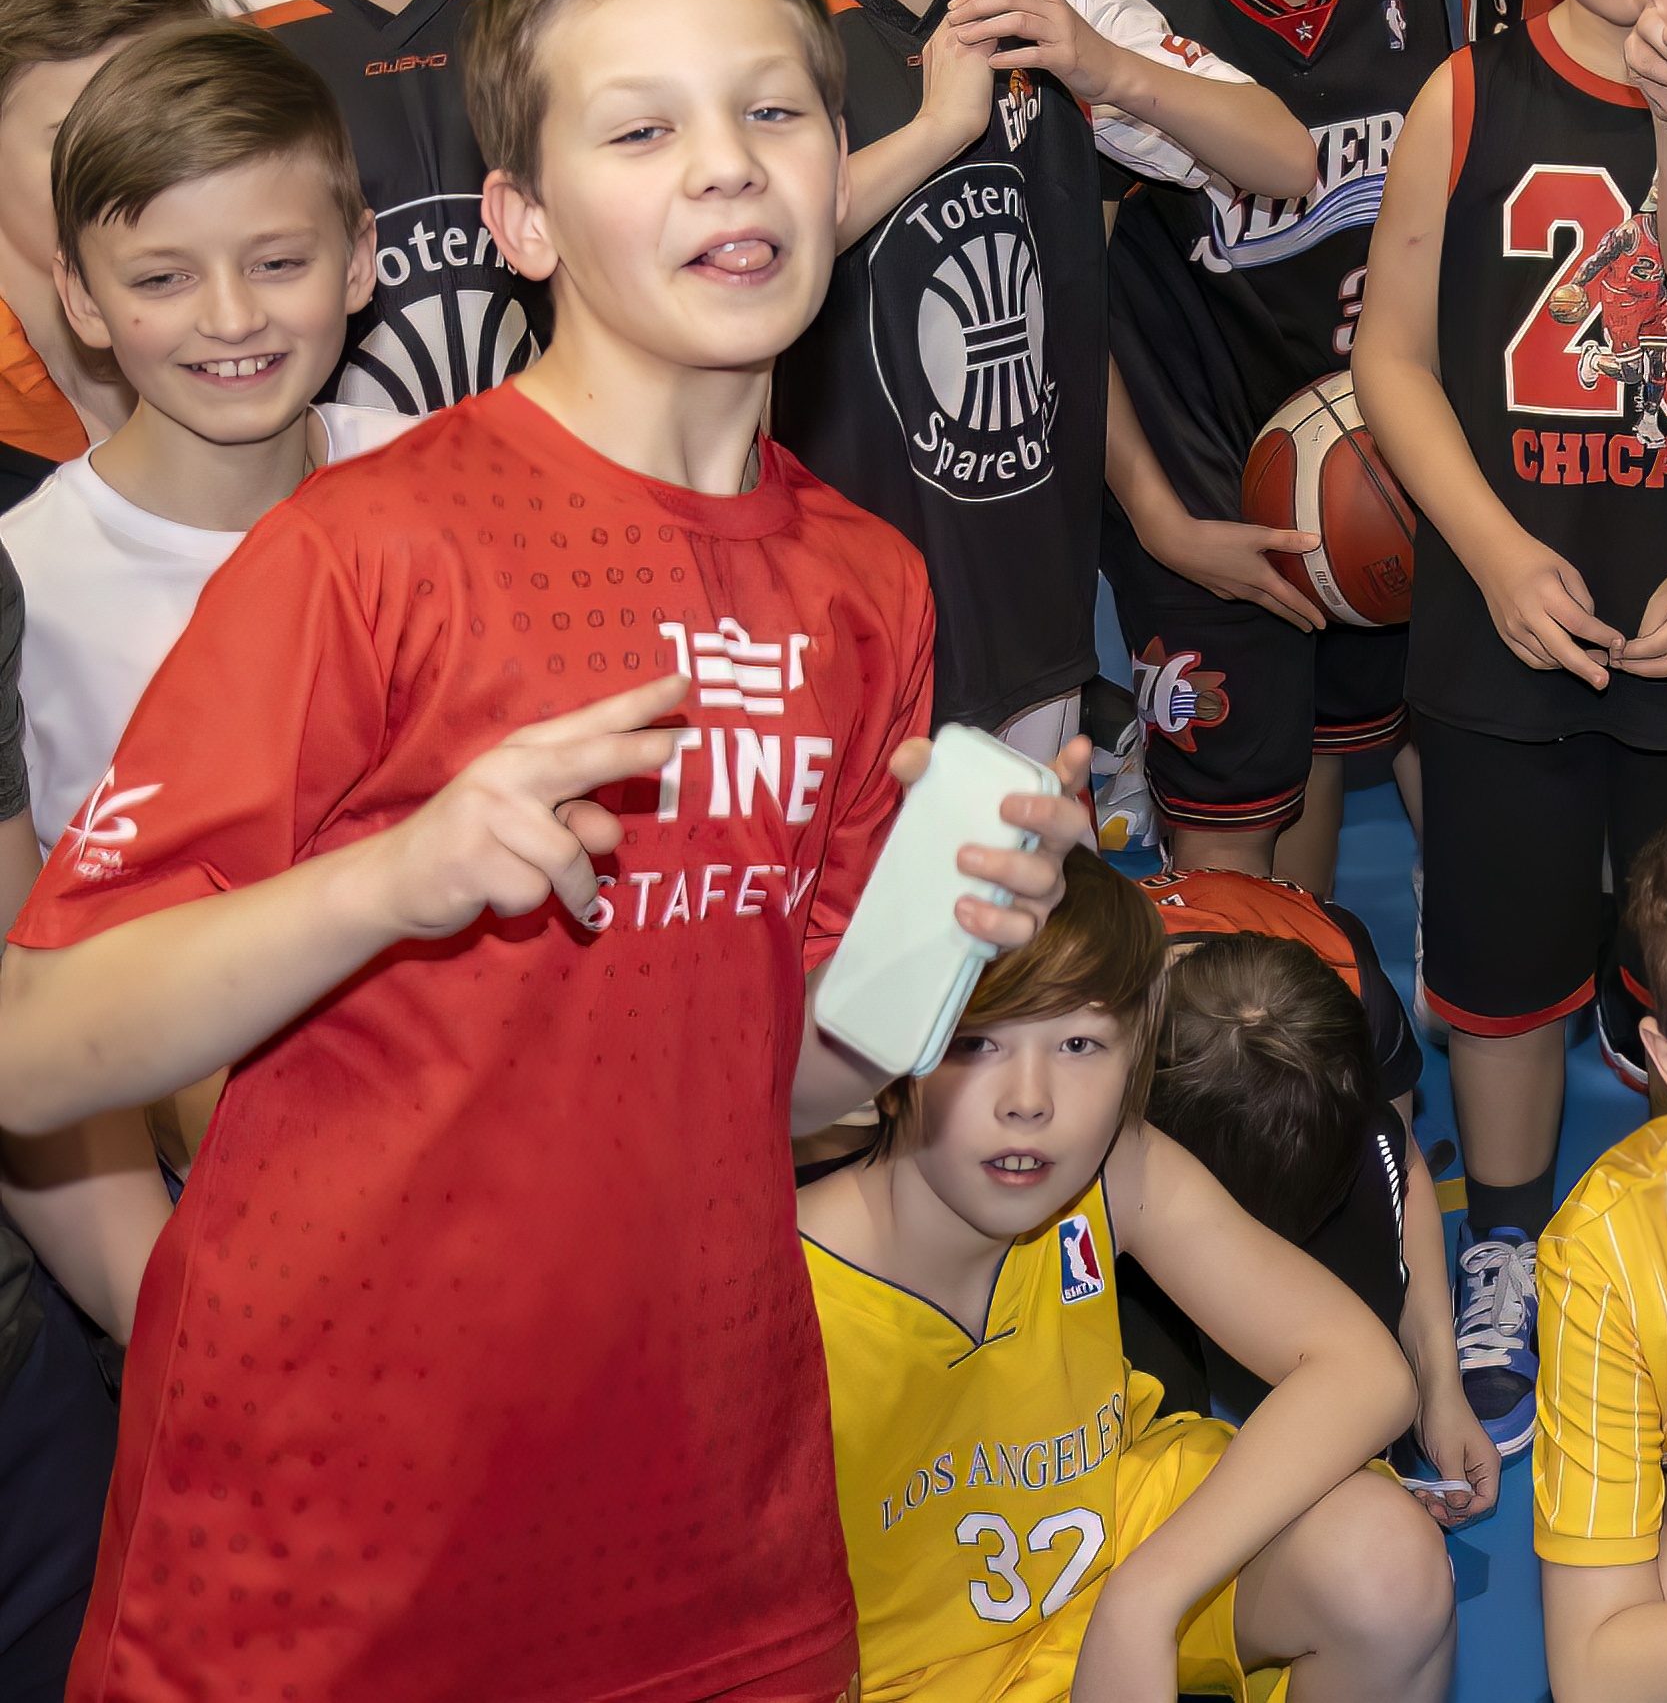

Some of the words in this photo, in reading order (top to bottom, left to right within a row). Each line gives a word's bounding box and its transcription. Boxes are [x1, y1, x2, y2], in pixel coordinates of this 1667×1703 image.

[376, 221, 517, 287] oten
[905, 182, 1025, 244] Toten
[657, 727, 834, 826] TINE
[881, 1451, 957, 1533] LOS
[966, 1392, 1125, 1491] ANGELES
[954, 1506, 1107, 1623] 32
